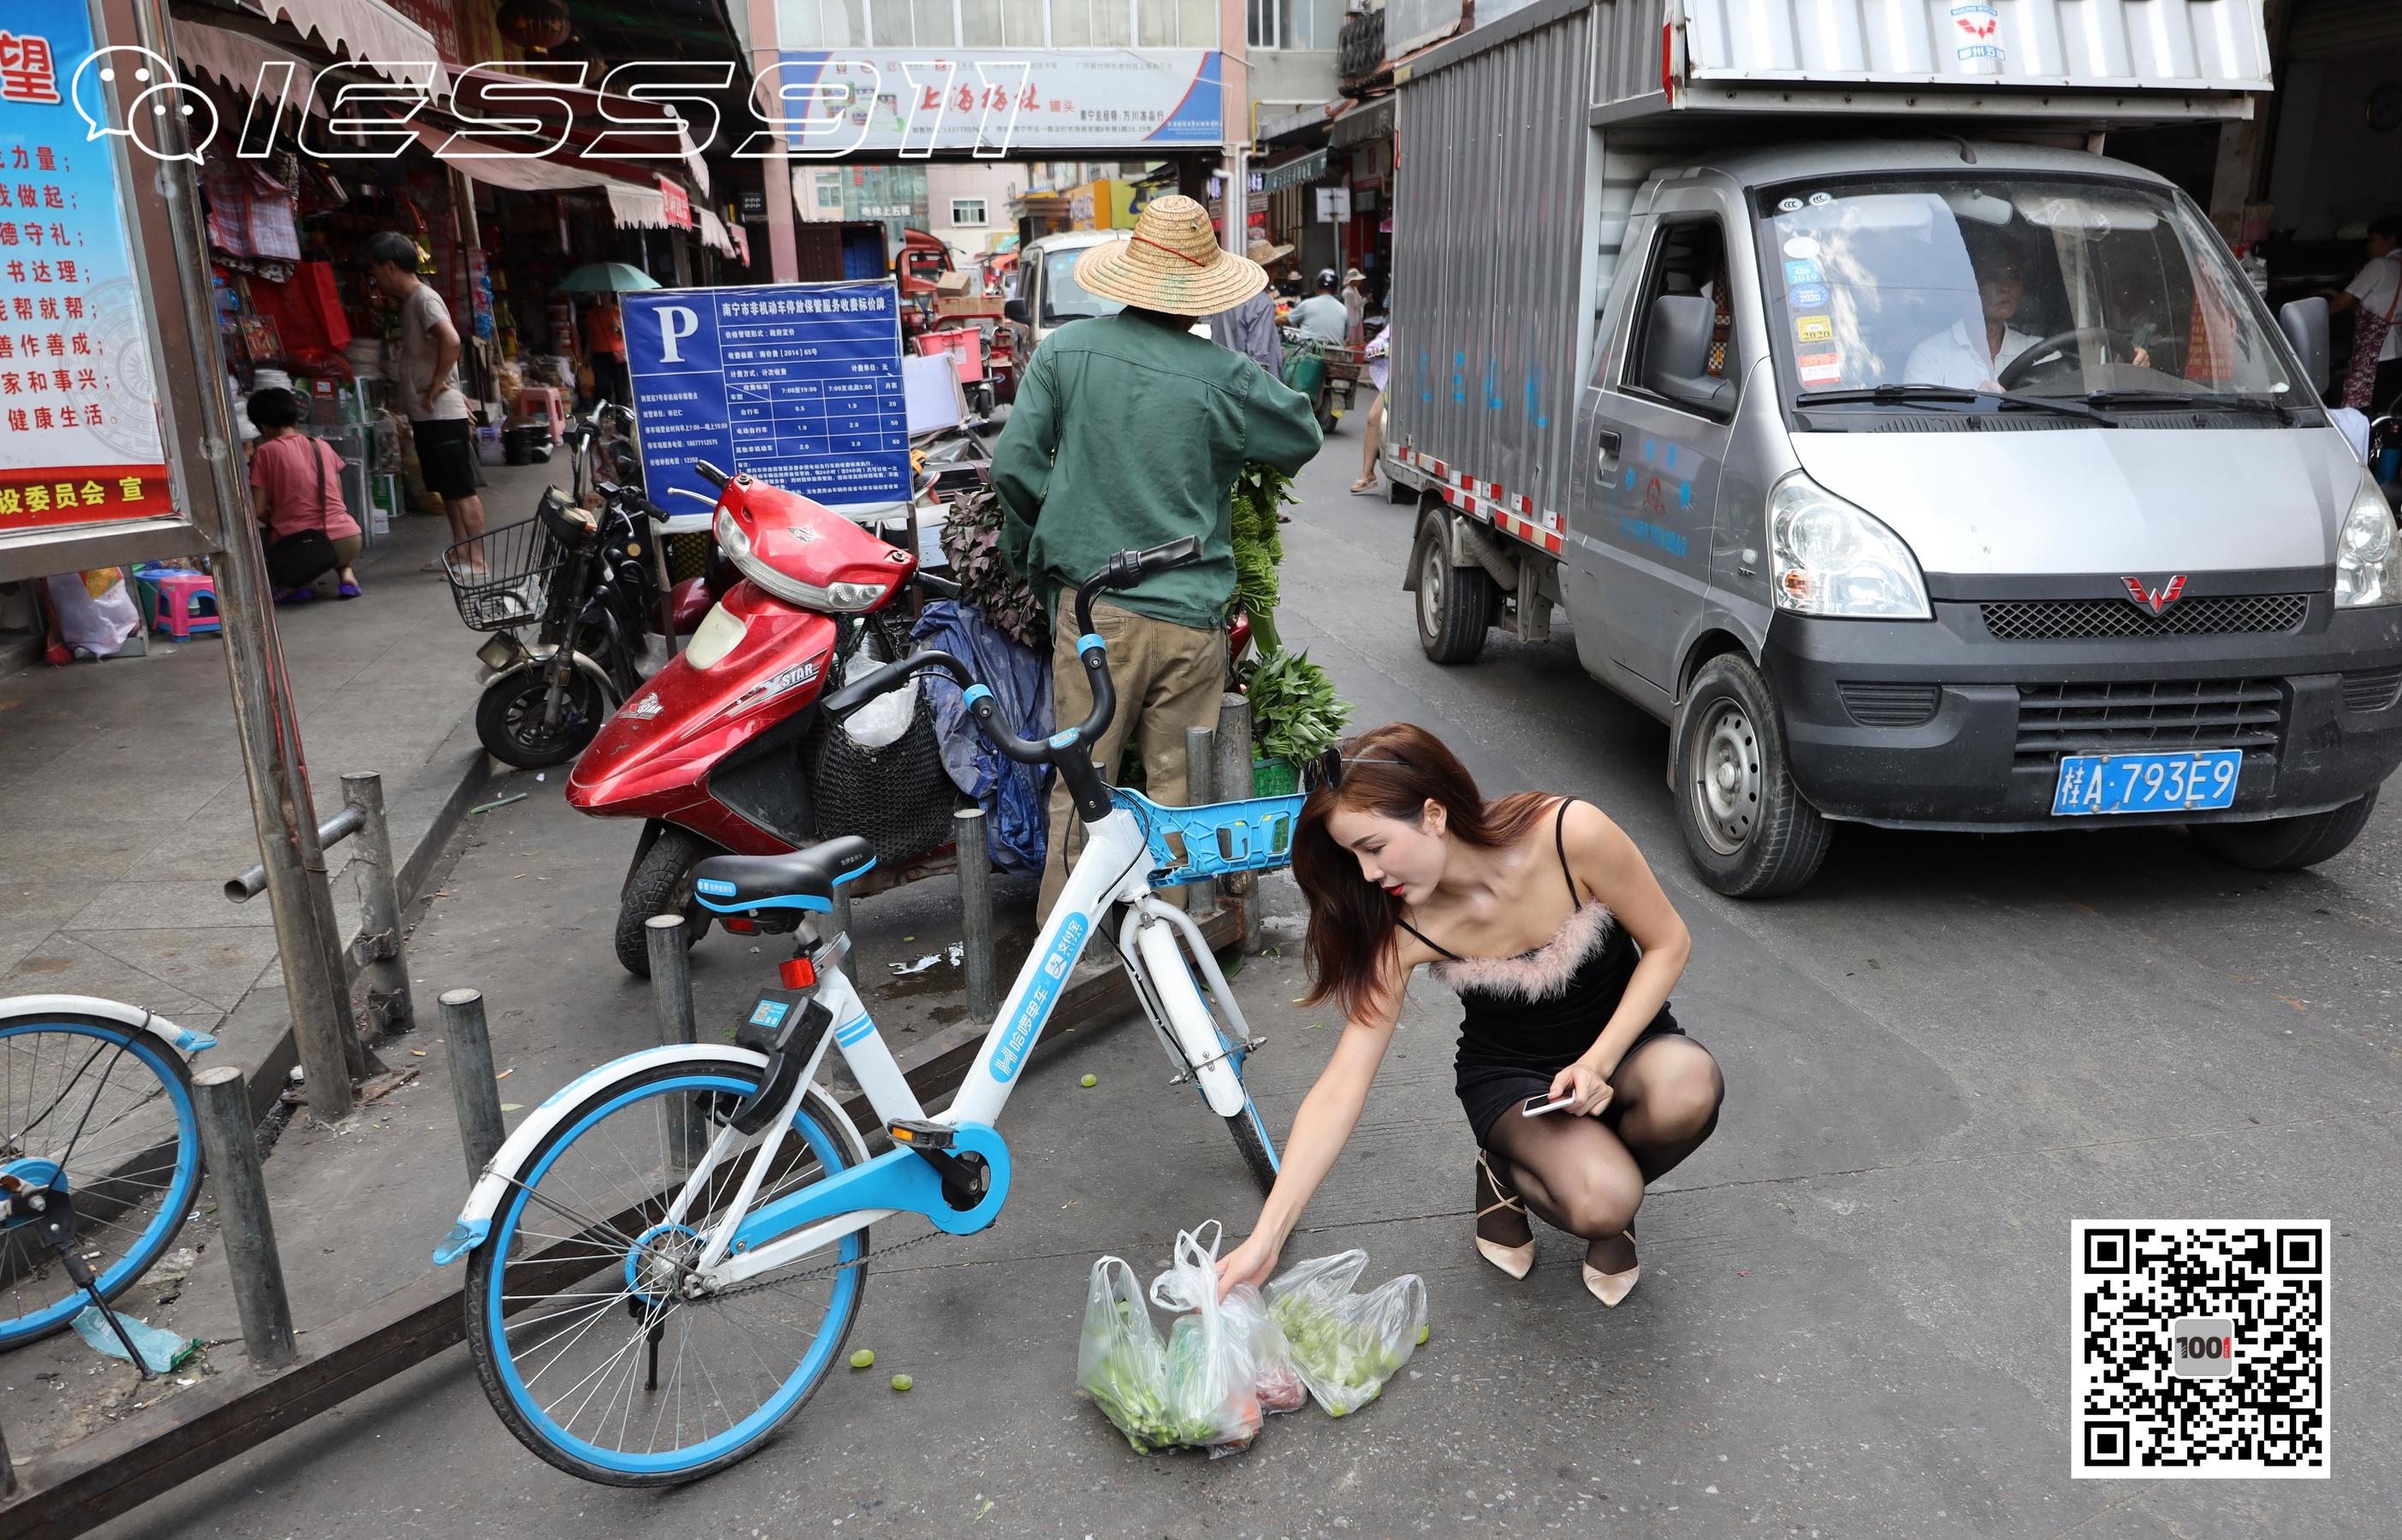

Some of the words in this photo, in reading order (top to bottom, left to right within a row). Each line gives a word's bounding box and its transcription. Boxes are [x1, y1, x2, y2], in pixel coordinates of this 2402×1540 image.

[1800, 293, 1821, 303] 2020
[652, 305, 699, 364] P
[1804, 329, 1830, 340] 2020
[119, 477, 145, 502] 宣
[1066, 927, 1084, 957] ALIPAY
